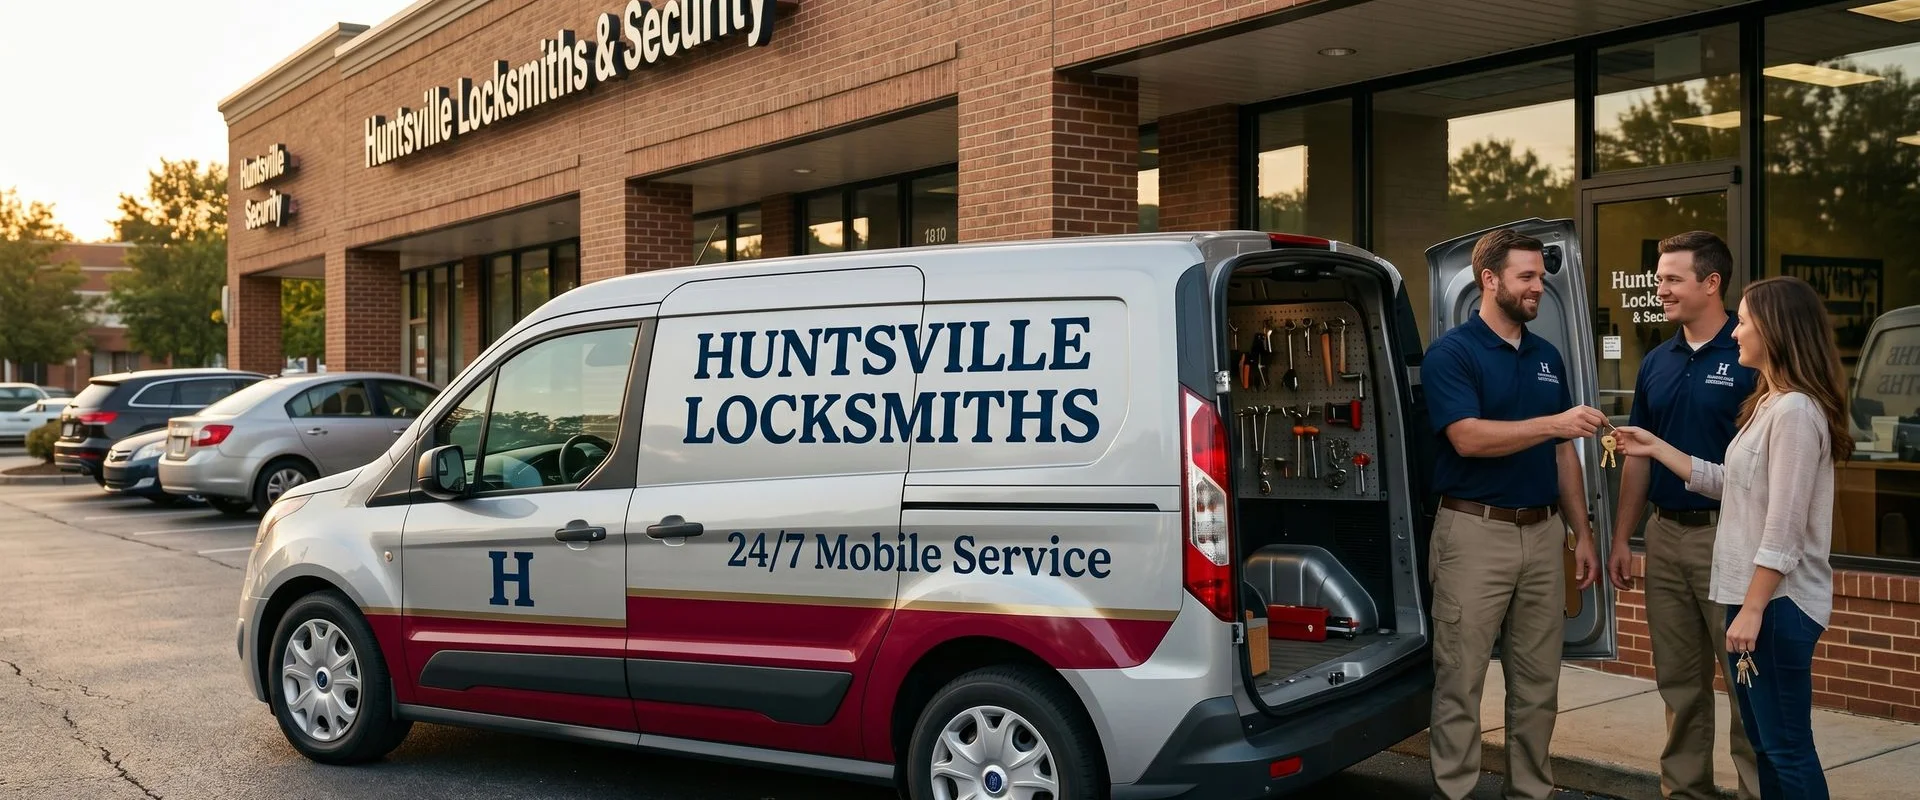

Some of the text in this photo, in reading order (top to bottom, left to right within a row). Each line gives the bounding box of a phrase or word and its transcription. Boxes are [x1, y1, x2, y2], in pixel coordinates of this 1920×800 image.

[364, 86, 453, 168] Huntsville
[457, 29, 588, 136] Locksmiths
[595, 12, 618, 82] &
[240, 143, 285, 190] Huntsville
[245, 188, 282, 231] Security
[924, 226, 947, 244] 1810
[1633, 312, 1641, 323] &
[693, 316, 1091, 380] HUNTSVILLE
[1540, 362, 1551, 373] H
[1716, 362, 1730, 375] H
[682, 387, 1101, 445] LOCKSMITHS
[726, 530, 1113, 579] 24/7 Mobile Service
[488, 551, 535, 607] H
